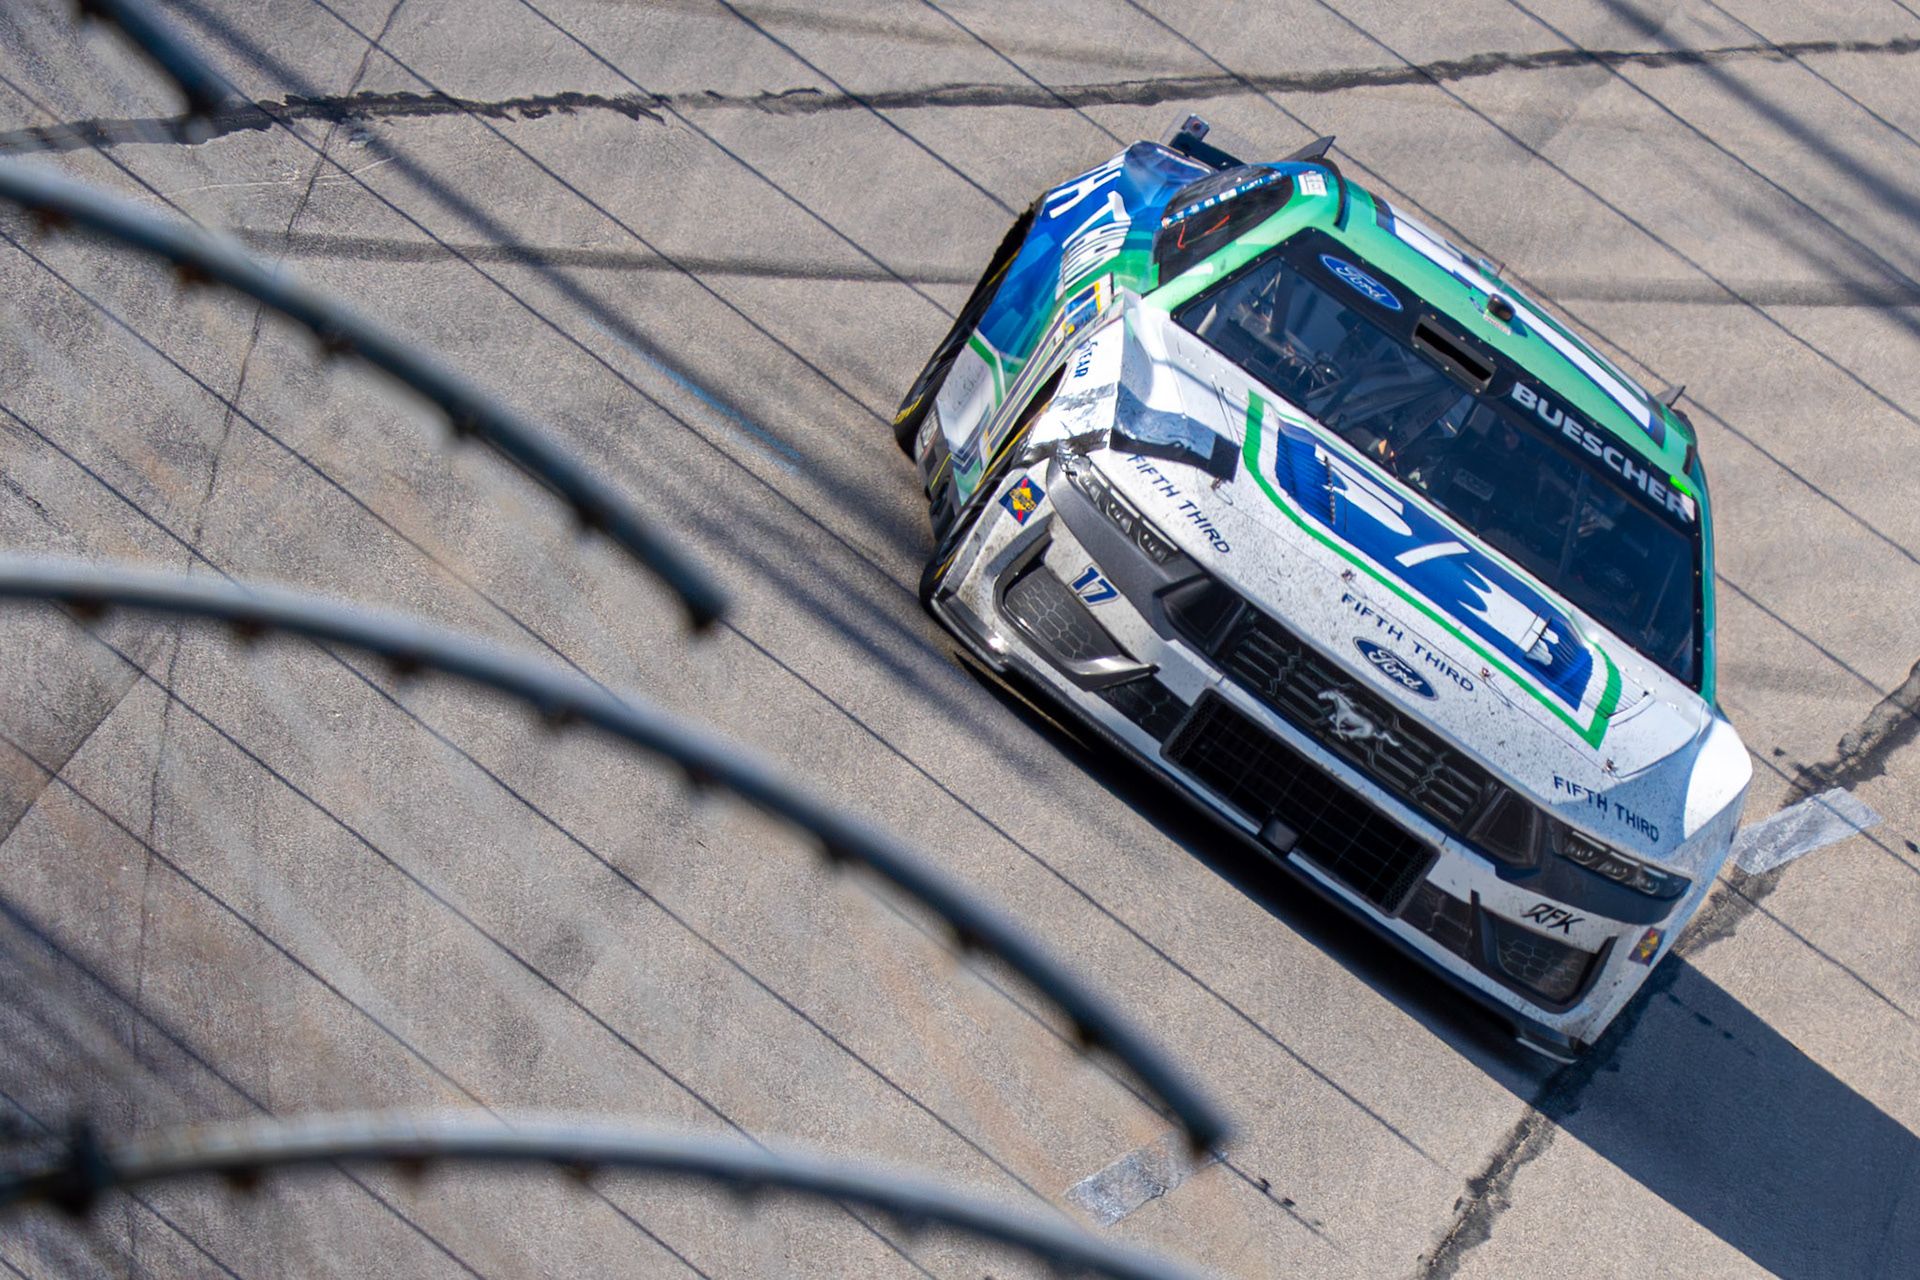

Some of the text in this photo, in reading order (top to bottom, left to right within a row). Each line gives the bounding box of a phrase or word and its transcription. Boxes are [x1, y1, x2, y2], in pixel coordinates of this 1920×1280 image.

[1335, 265, 1388, 301] Ford
[1511, 381, 1692, 523] BUESCHER
[1127, 455, 1231, 554] FIFTH THIRD
[1069, 565, 1119, 605] 17
[1341, 593, 1474, 692] FIFTH THIRD
[1368, 649, 1424, 691] Ford
[1553, 775, 1660, 843] FIFTH THIRD
[1521, 903, 1585, 935] RFK
